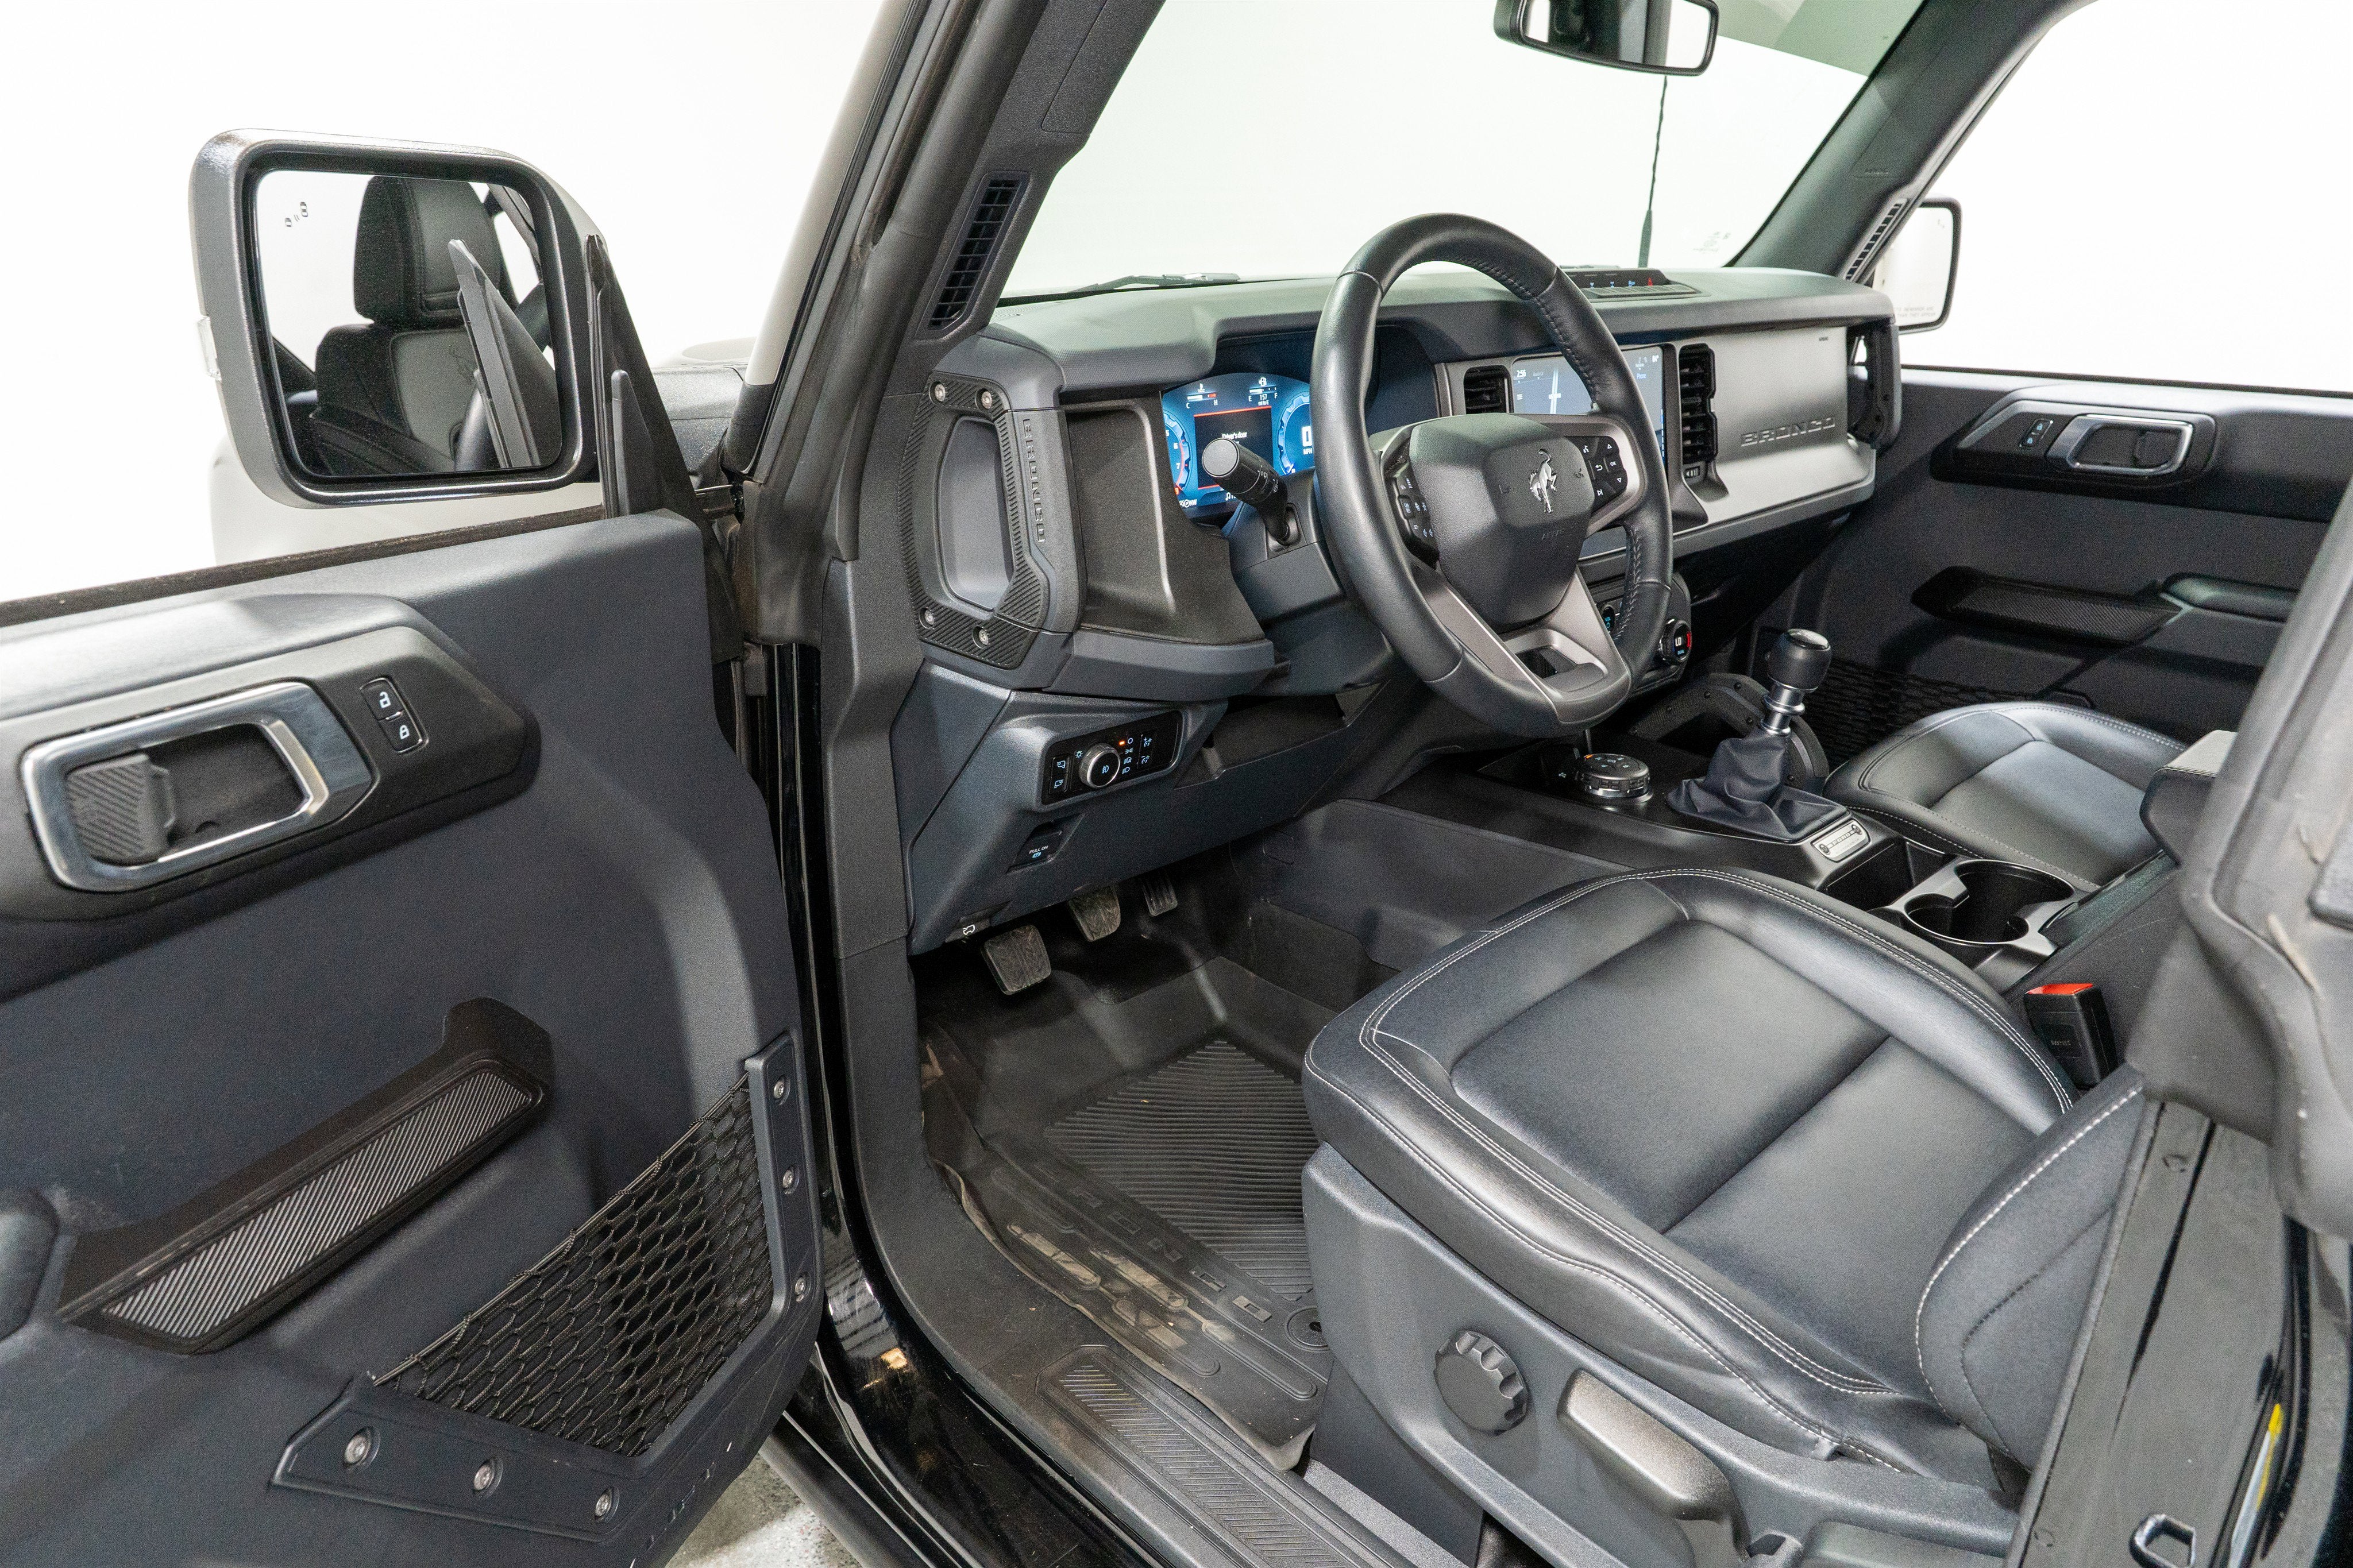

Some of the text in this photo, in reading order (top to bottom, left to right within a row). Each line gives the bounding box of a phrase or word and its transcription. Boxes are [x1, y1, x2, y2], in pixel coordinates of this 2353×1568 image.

[1302, 426, 1313, 447] 0
[1741, 417, 1835, 447] BRONCO
[1023, 419, 1046, 542] BRONCO
[1833, 832, 1851, 846] FORD
